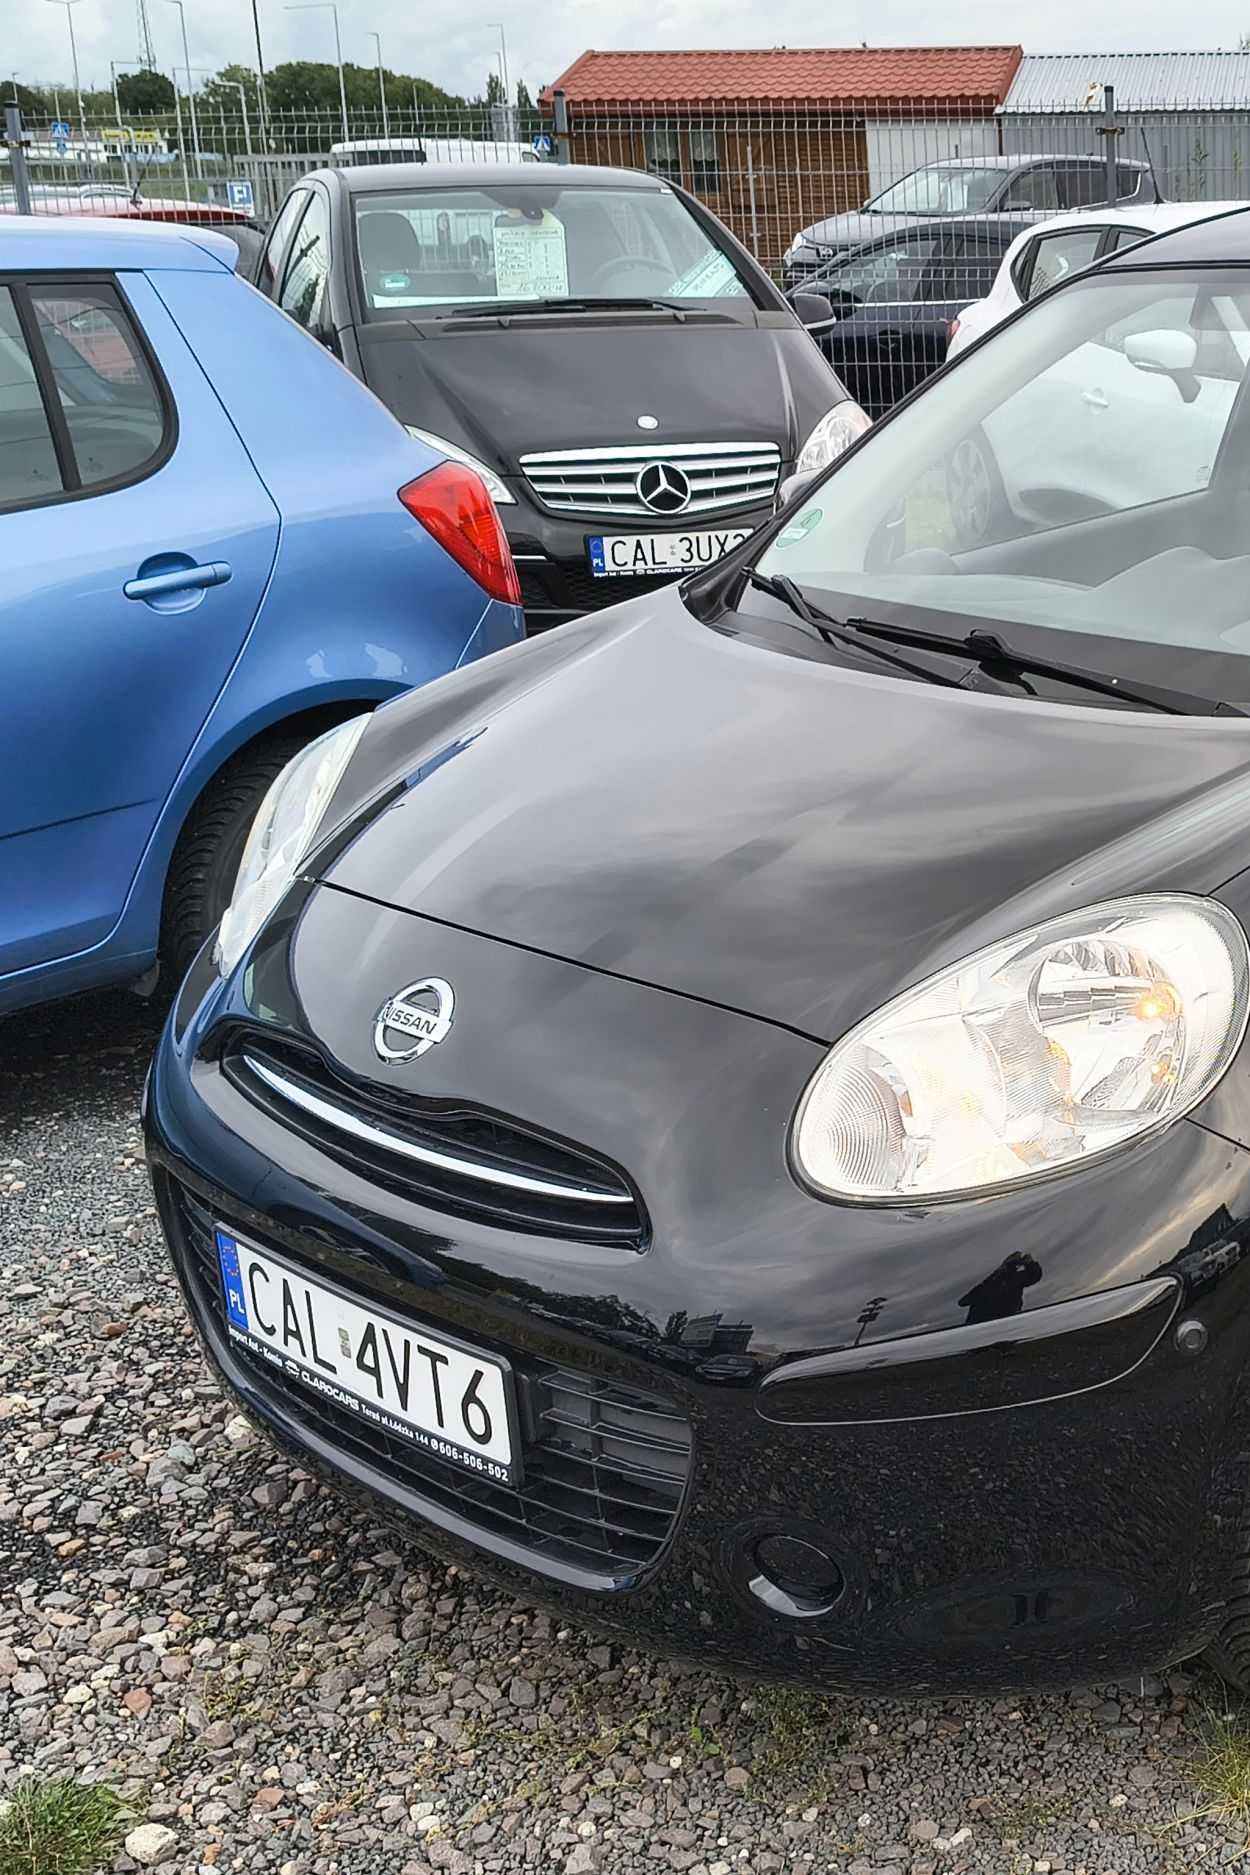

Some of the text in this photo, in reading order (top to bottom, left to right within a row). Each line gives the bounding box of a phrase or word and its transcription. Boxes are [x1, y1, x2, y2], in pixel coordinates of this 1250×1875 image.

[592, 558, 604, 567] PL
[611, 538, 667, 567] CAL
[384, 1005, 437, 1035] NISSAN
[228, 1288, 246, 1315] PL
[248, 1262, 493, 1446] CAL 4VT6
[301, 1370, 360, 1411] CLAROCARS
[439, 1442, 509, 1482] 606-506-502
